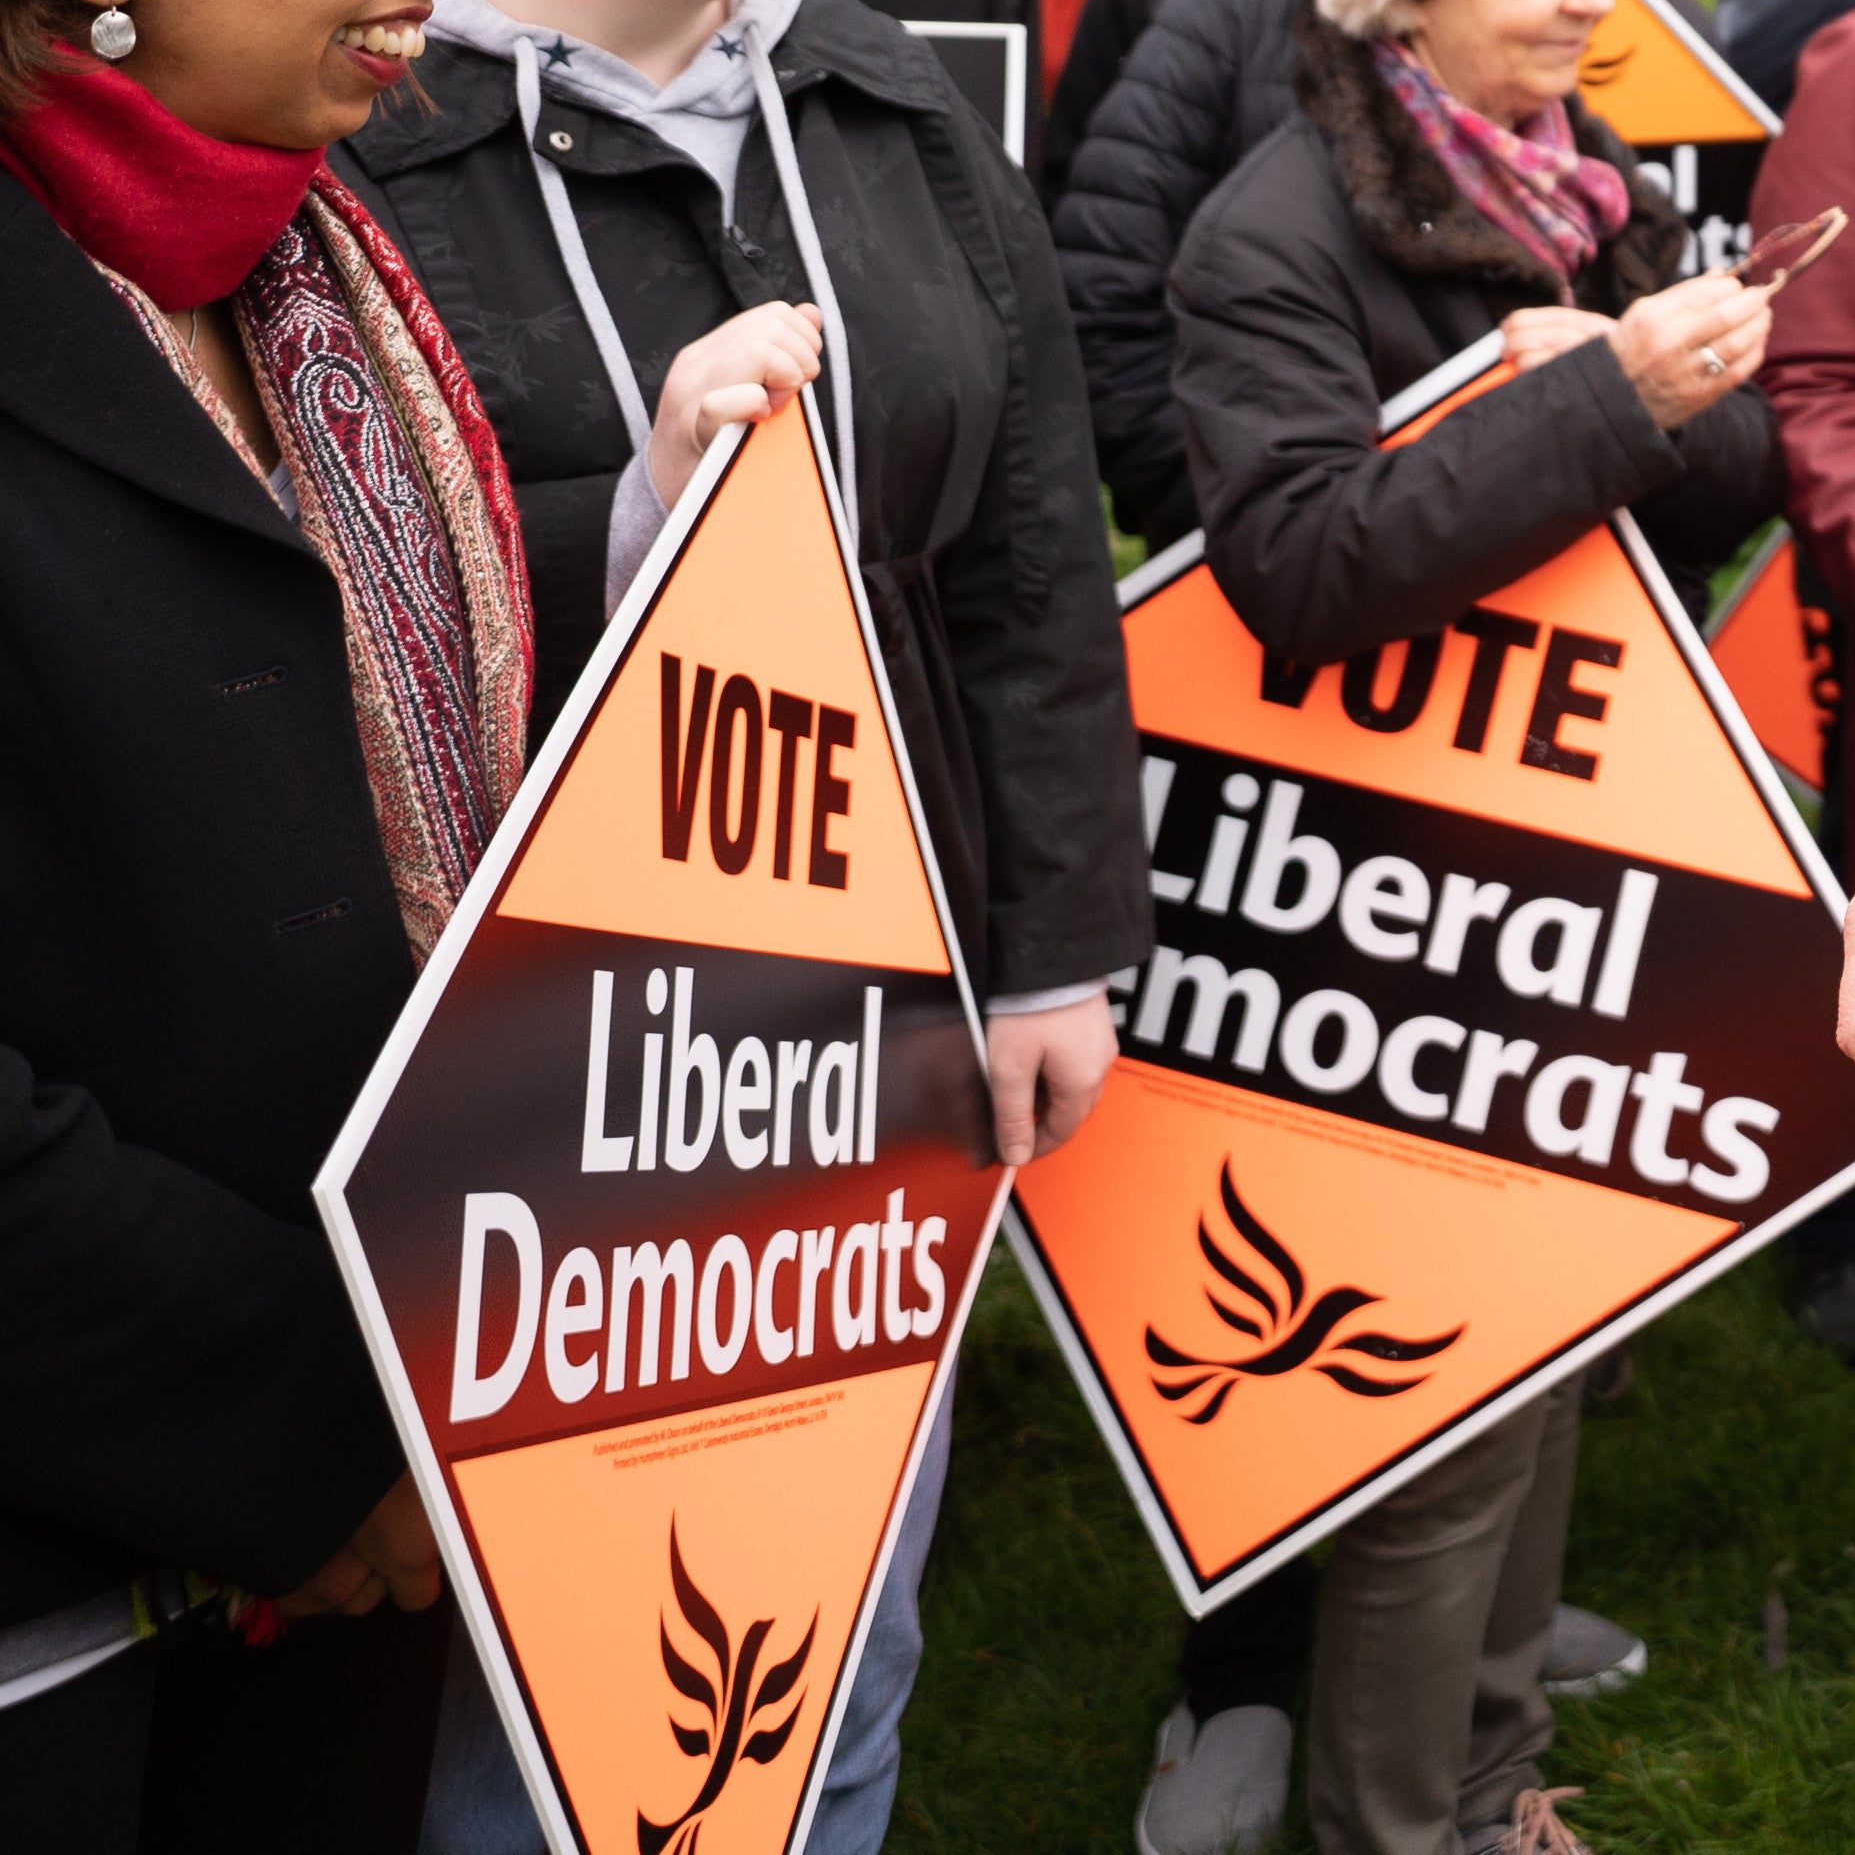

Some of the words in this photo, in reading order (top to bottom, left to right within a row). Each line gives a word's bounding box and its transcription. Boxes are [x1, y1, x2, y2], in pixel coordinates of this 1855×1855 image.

[660, 651, 858, 891] VOTE
[581, 967, 883, 1173] Liberal
[449, 1187, 947, 1423] Democrats
